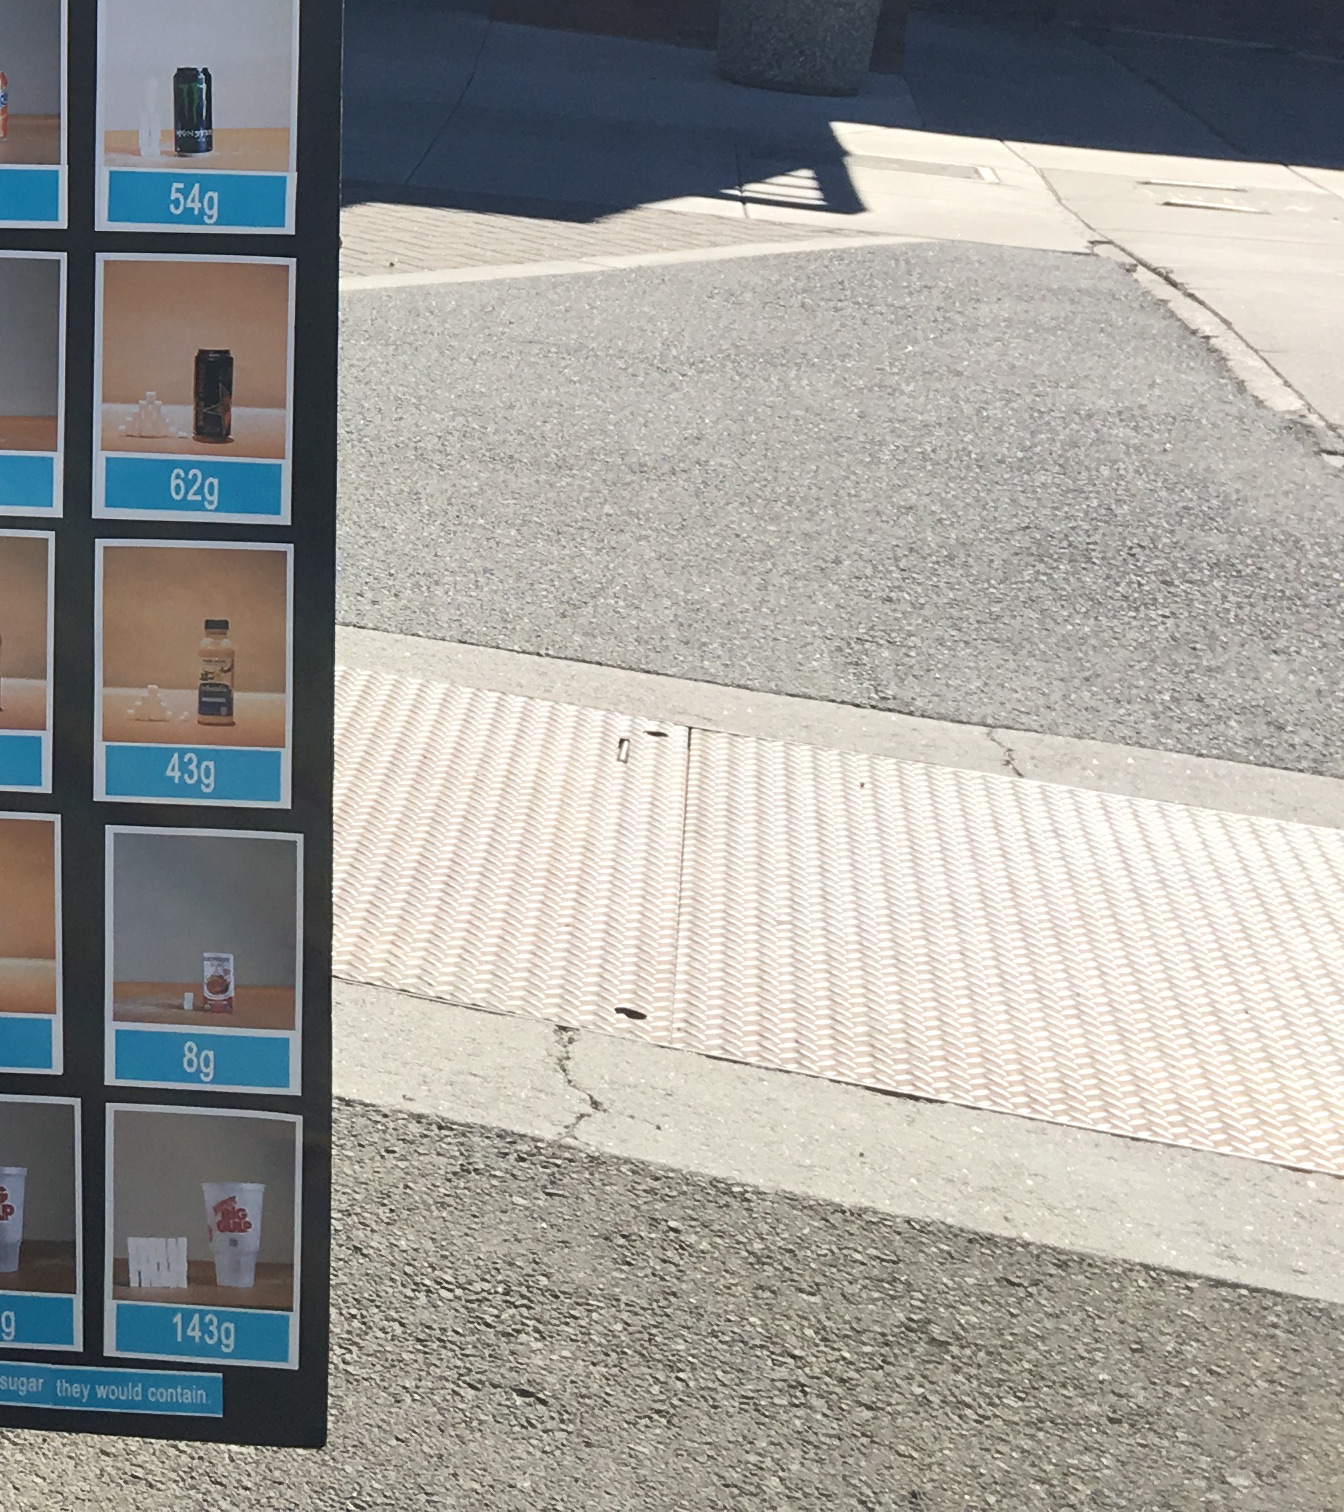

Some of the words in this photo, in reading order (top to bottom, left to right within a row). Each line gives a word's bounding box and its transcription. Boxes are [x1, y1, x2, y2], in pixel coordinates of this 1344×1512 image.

[169, 182, 219, 224] 54g
[170, 468, 219, 510] 62g
[166, 753, 216, 793] 43g
[182, 1042, 215, 1082] 8g
[172, 1313, 236, 1354] 143g
[0, 1374, 44, 1395] sugar
[56, 1379, 90, 1402] they
[95, 1382, 142, 1401] would
